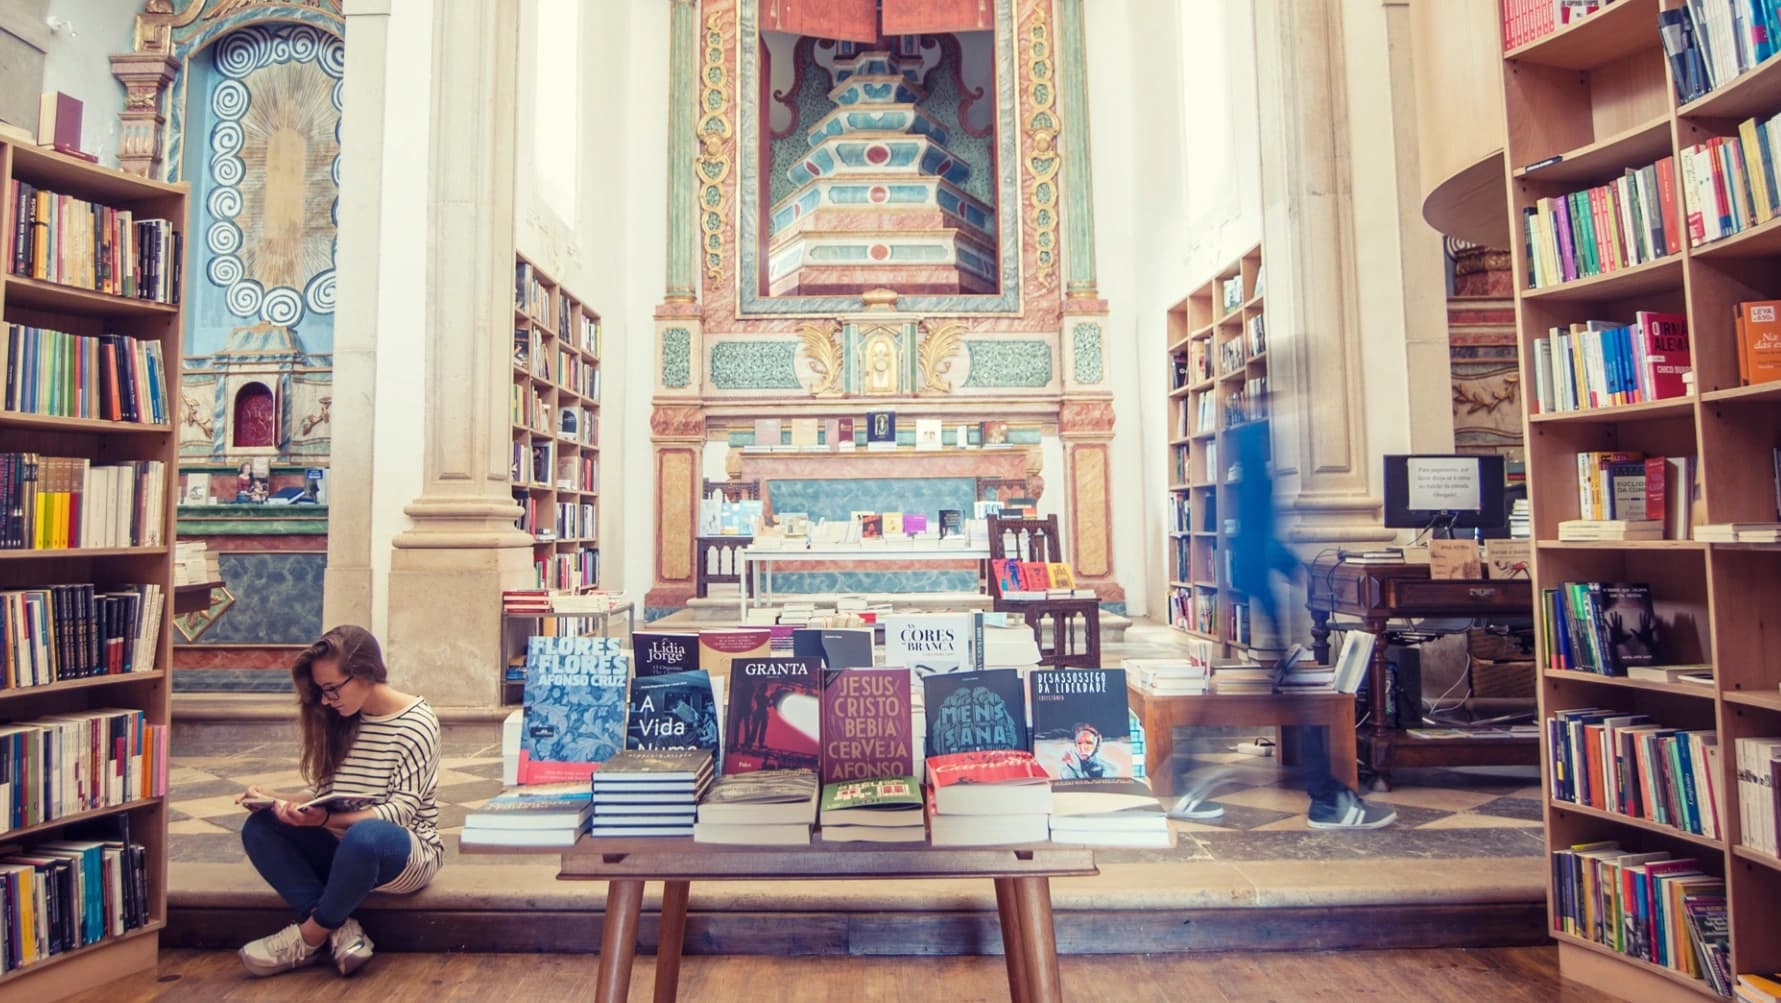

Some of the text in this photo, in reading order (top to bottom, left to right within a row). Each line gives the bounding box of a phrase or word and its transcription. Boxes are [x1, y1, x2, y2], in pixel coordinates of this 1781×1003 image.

[900, 629, 955, 642] CORES
[532, 636, 621, 656] FLORES
[652, 640, 686, 654] Lídia
[907, 641, 954, 652] BRANCA
[539, 654, 627, 675] FLORES
[646, 648, 683, 664] Jorge
[745, 663, 809, 676] GRANTA
[1037, 671, 1107, 684] DESASSOSSEGO
[538, 674, 589, 687] AFONSO
[590, 674, 626, 687] CRUZ
[839, 676, 895, 697] JESUS
[1038, 681, 1107, 694] DA LIBERDADE
[639, 695, 655, 713] A
[834, 697, 900, 718] CRISTO
[941, 703, 1005, 724] MENS
[639, 717, 685, 737] Vida
[845, 718, 897, 738] BEBIA
[944, 725, 1007, 746] SANA
[828, 739, 909, 760] CERVEJA
[831, 761, 905, 780] AFONSO
